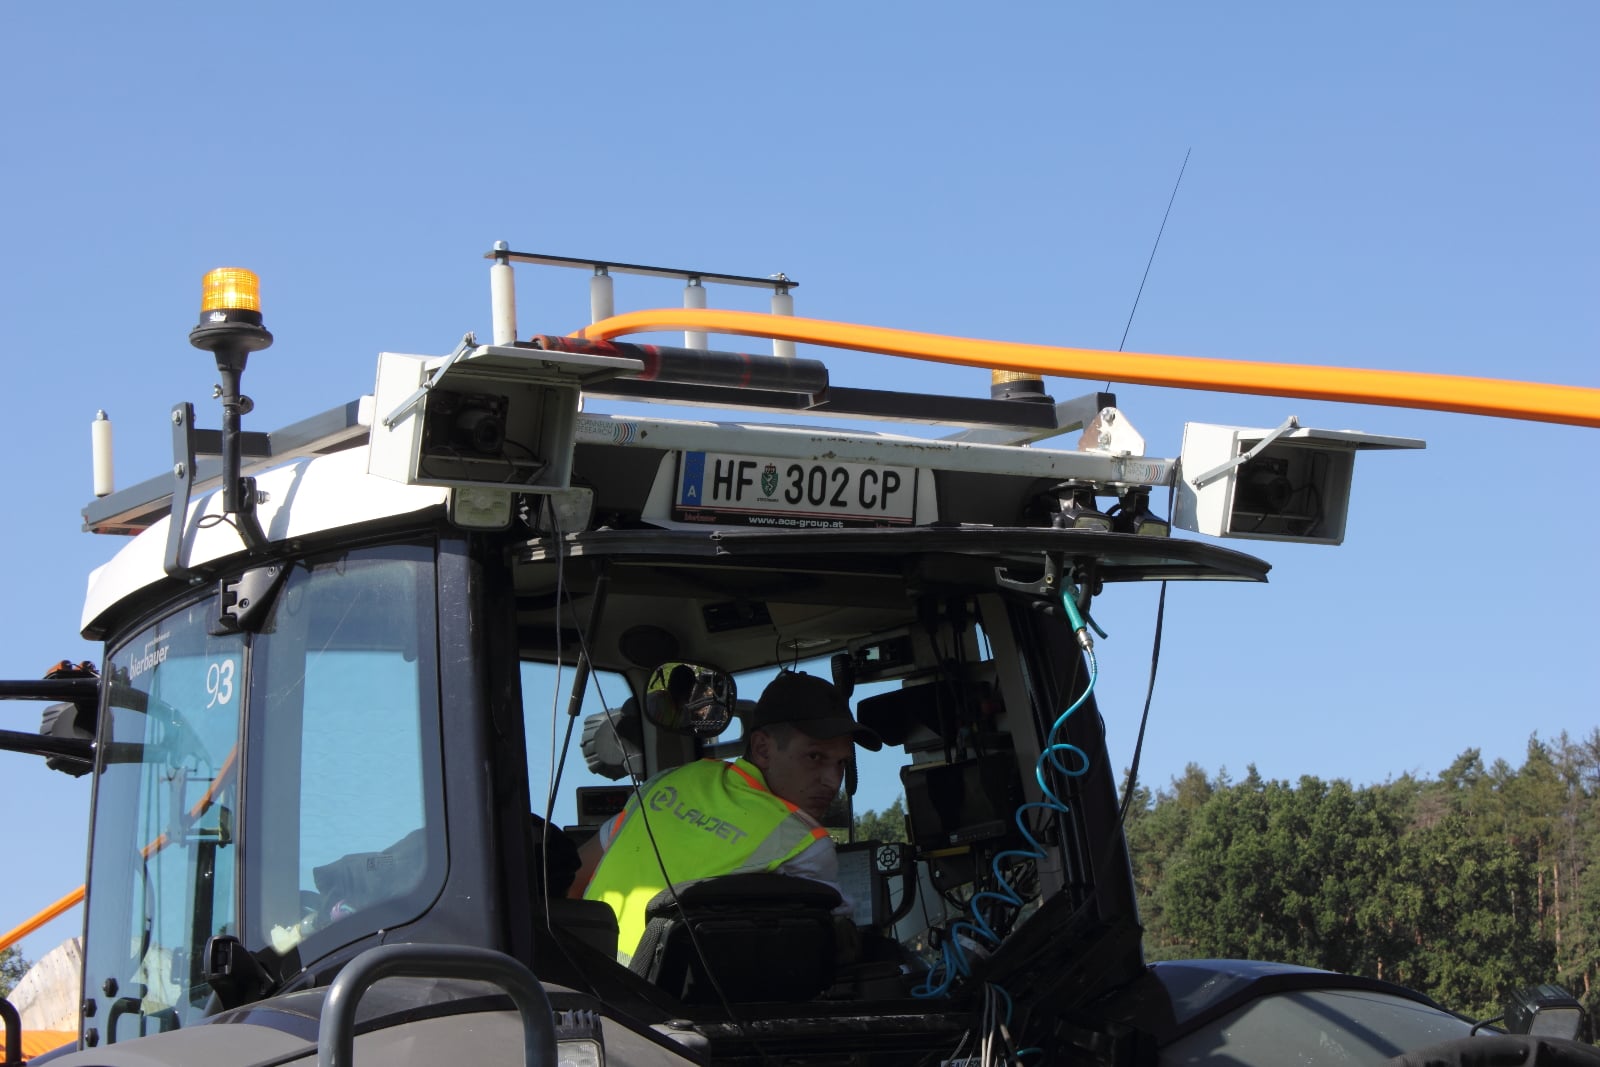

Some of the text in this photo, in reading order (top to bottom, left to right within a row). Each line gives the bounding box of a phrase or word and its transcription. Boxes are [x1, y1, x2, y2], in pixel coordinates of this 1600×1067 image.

[687, 485, 697, 498] A
[713, 459, 901, 510] HF 302 CP
[748, 516, 844, 529] www.aca-group.at
[130, 644, 170, 680] bierbauer
[206, 659, 235, 709] 93
